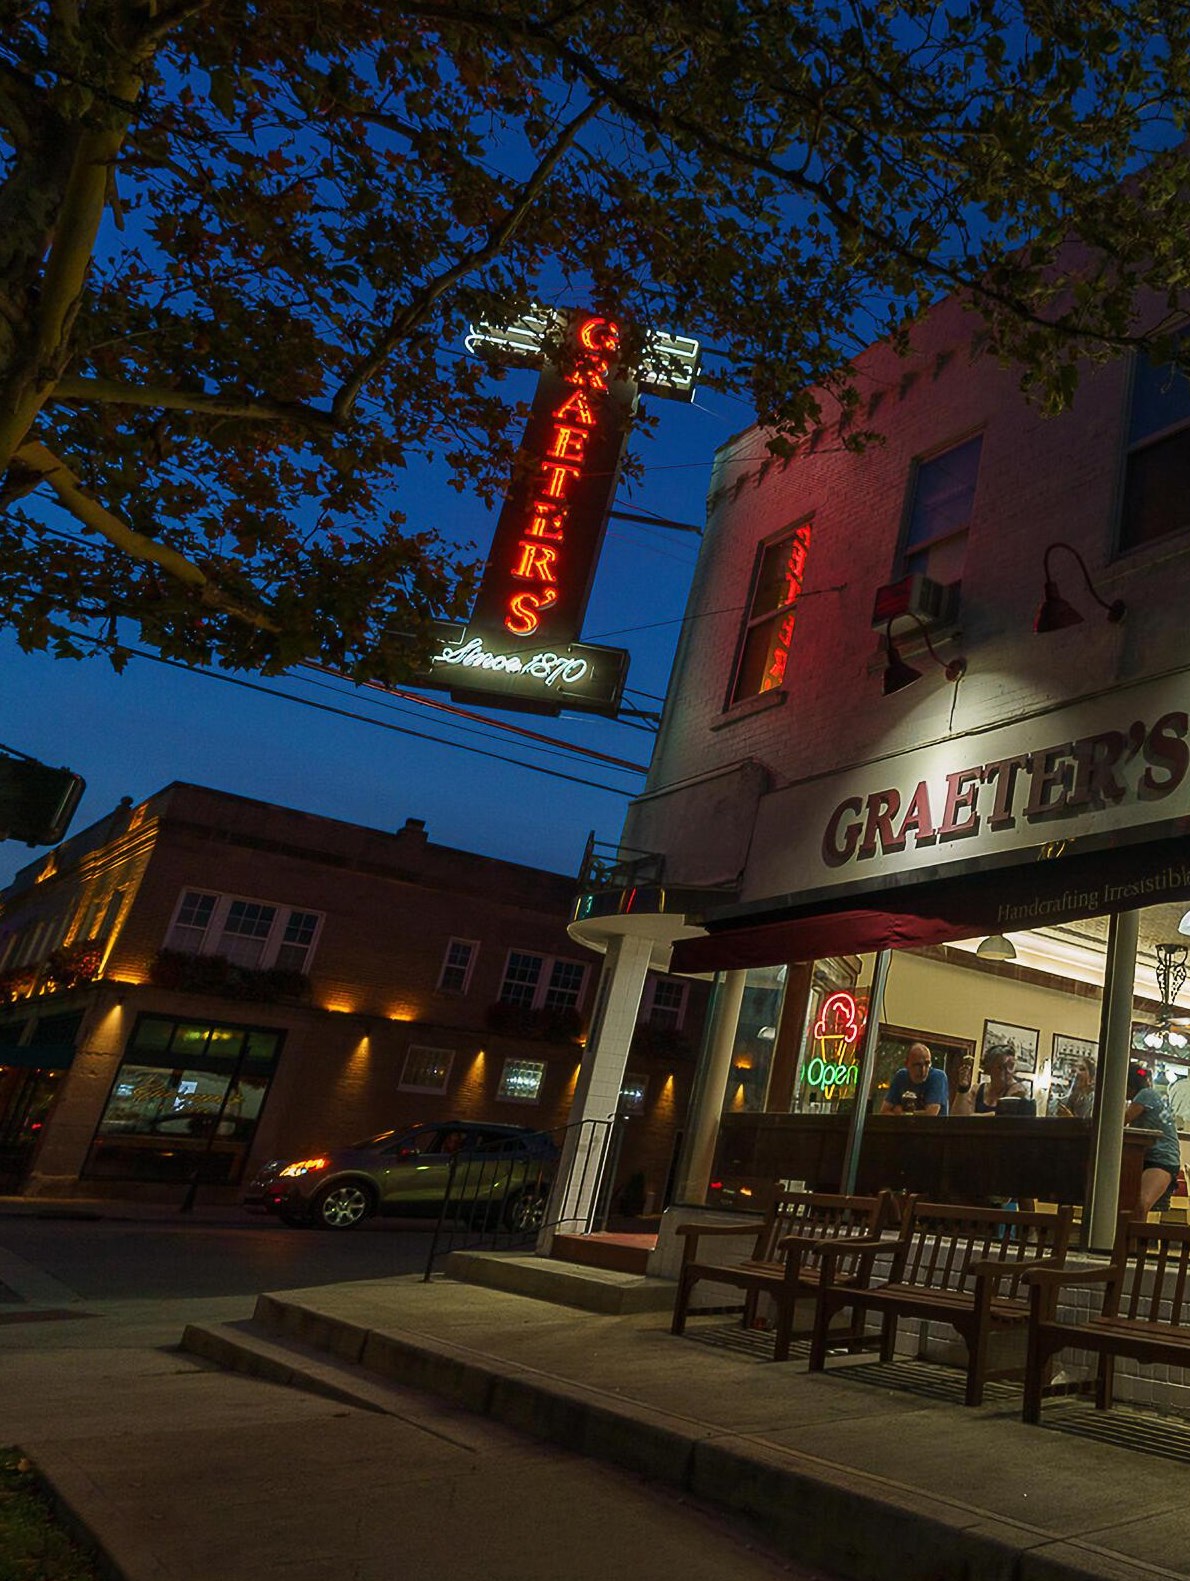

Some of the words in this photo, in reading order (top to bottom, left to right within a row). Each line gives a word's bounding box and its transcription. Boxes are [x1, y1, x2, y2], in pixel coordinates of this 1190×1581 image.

[521, 652, 587, 687] 1870
[821, 711, 1190, 869] GRAETER'S
[997, 890, 1100, 923] Handcrafting
[807, 1057, 859, 1091] Open
